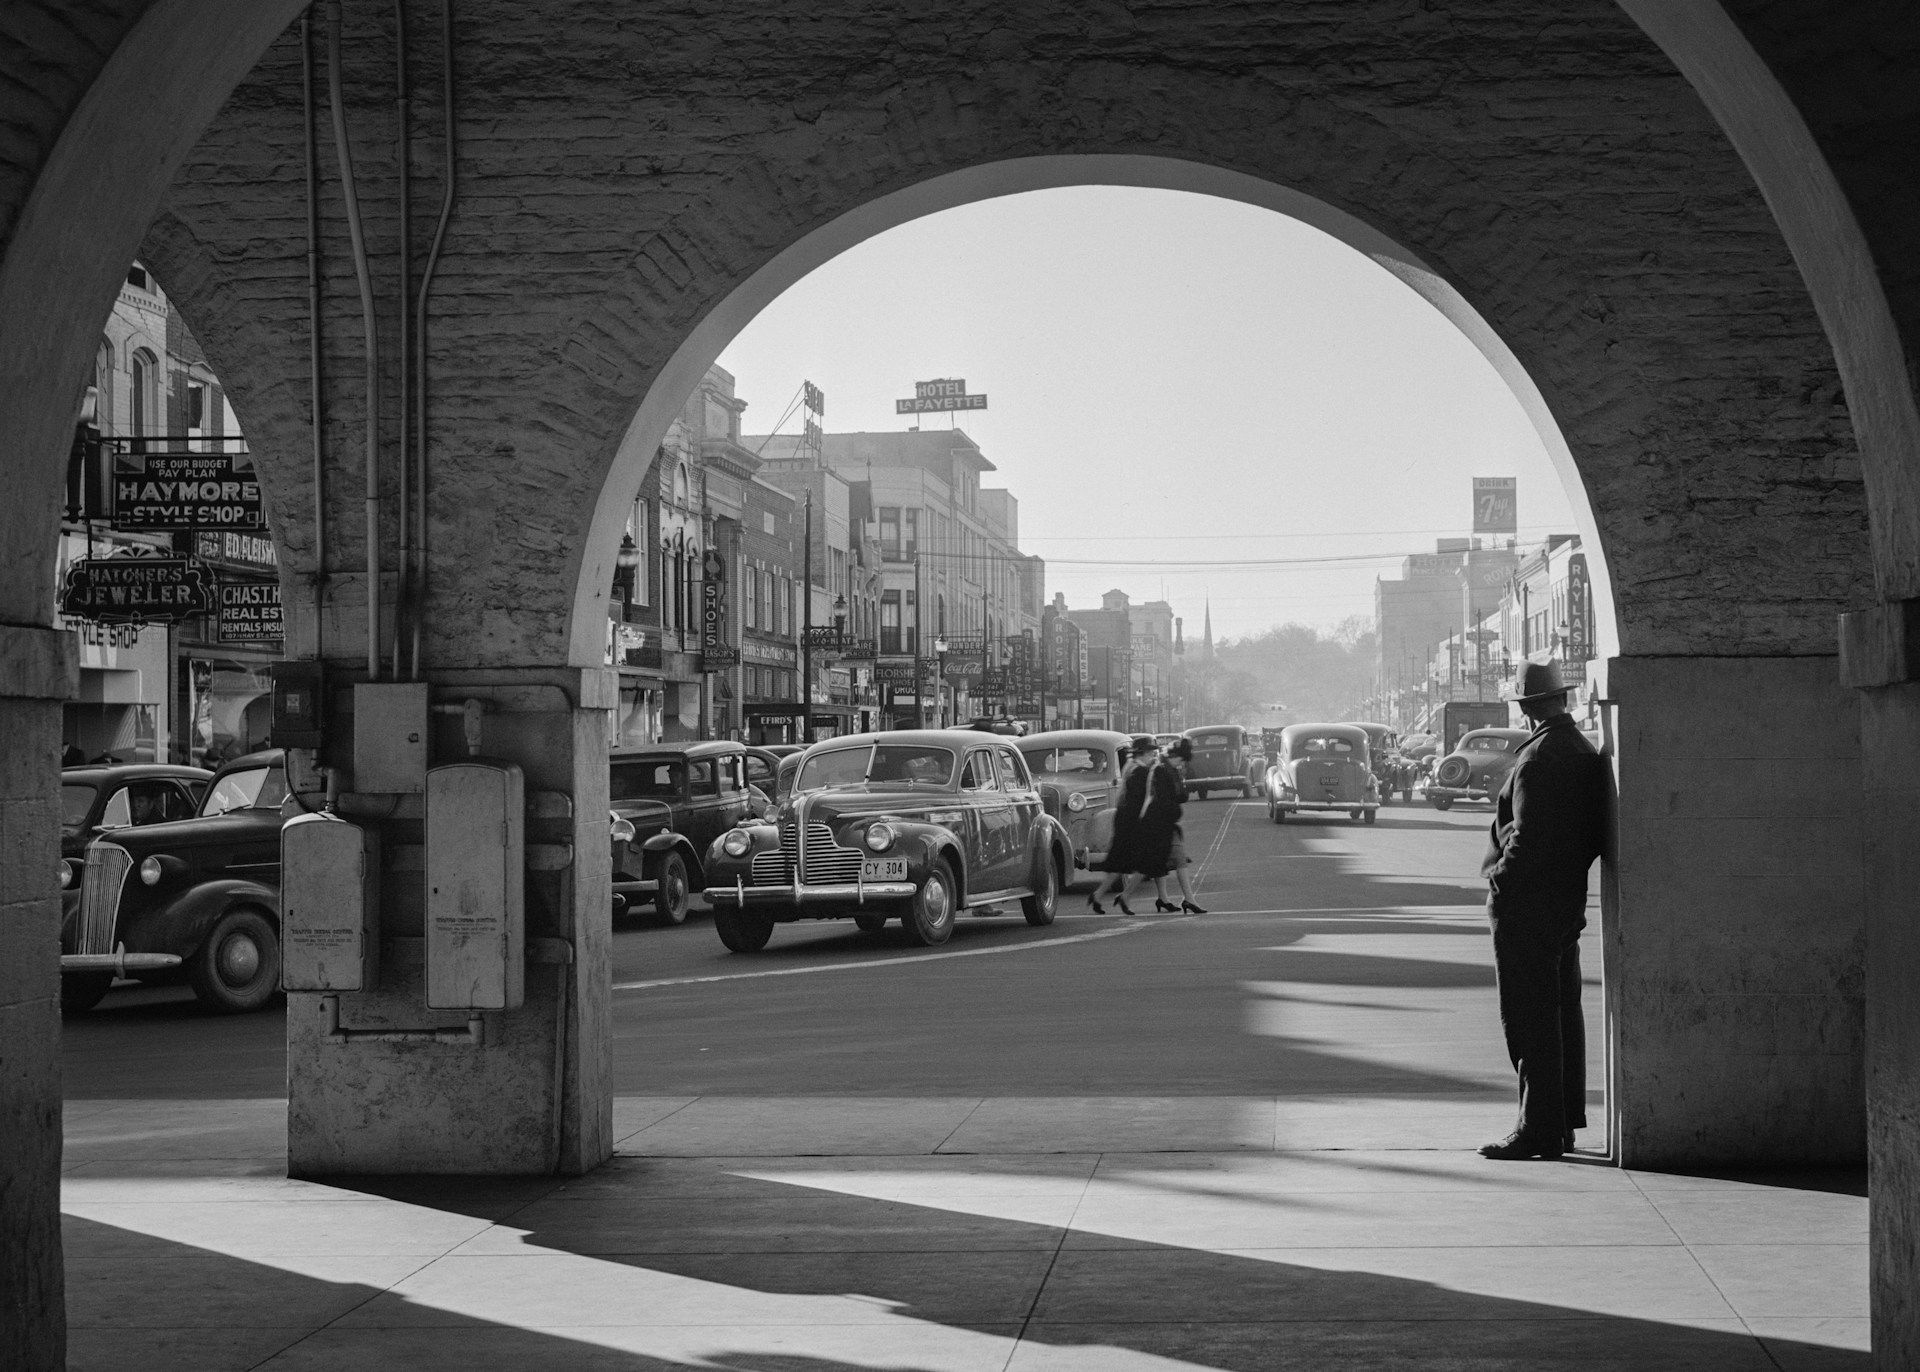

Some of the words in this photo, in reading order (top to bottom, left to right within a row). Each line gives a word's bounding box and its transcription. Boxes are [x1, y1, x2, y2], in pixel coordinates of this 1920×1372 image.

[918, 383, 964, 397] HOTEL
[915, 396, 984, 411] FAYETTE
[150, 459, 166, 469] USE
[170, 459, 189, 469] OUR
[192, 459, 228, 469] BUDGET
[159, 469, 180, 478] PAY
[185, 469, 216, 478] PLAN
[118, 481, 260, 502] HAYMORE
[133, 505, 194, 523] STYLE
[197, 505, 245, 523] SHOP
[79, 585, 191, 605] JEWELER
[222, 607, 259, 620] REAL
[705, 585, 717, 646] SHOES
[1080, 632, 1088, 680] KRESS
[760, 715, 793, 725] EFIRD'S
[865, 862, 879, 875] CY
[886, 861, 903, 875] 304
